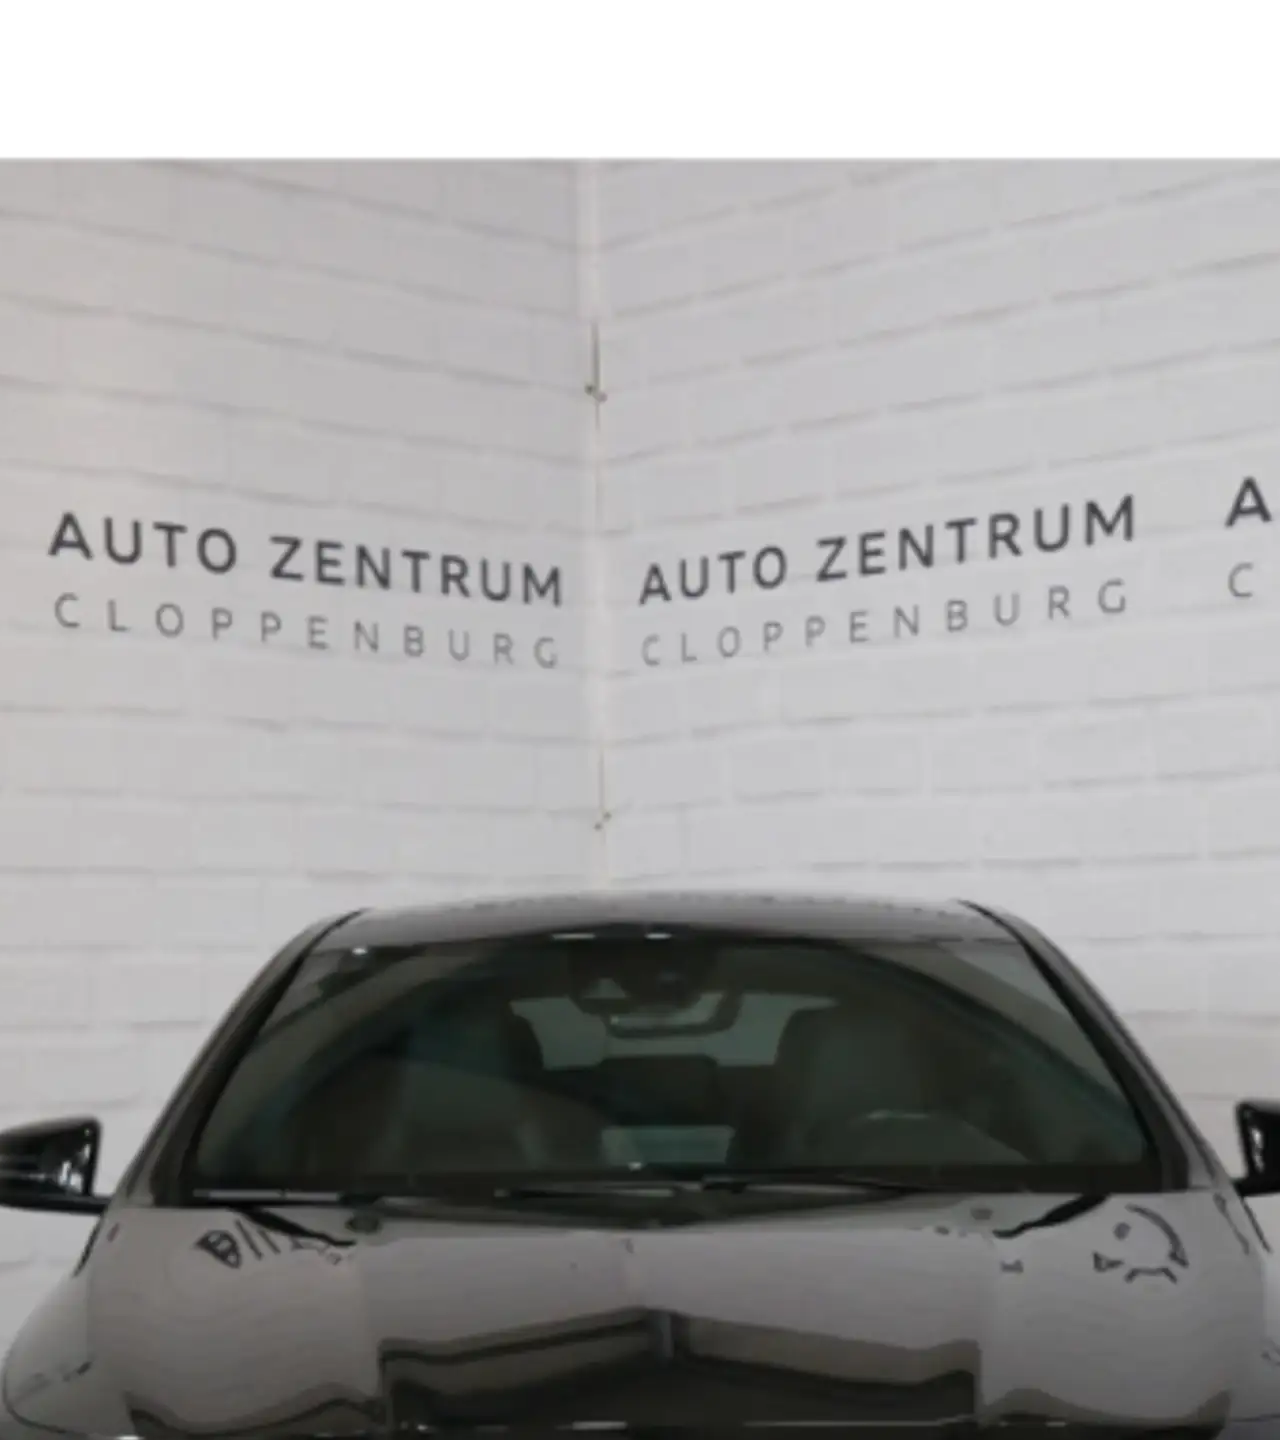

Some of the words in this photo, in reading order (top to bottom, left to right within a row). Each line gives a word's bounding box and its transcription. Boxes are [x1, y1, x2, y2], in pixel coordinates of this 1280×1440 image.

[47, 512, 237, 575] AUTO
[270, 535, 561, 607] ZENTRUM
[639, 545, 787, 605] AUTO
[816, 495, 1134, 583] ZENTRUM
[54, 592, 558, 670] CLOPPENBURG
[642, 578, 1126, 668] CLOPPENBURG
